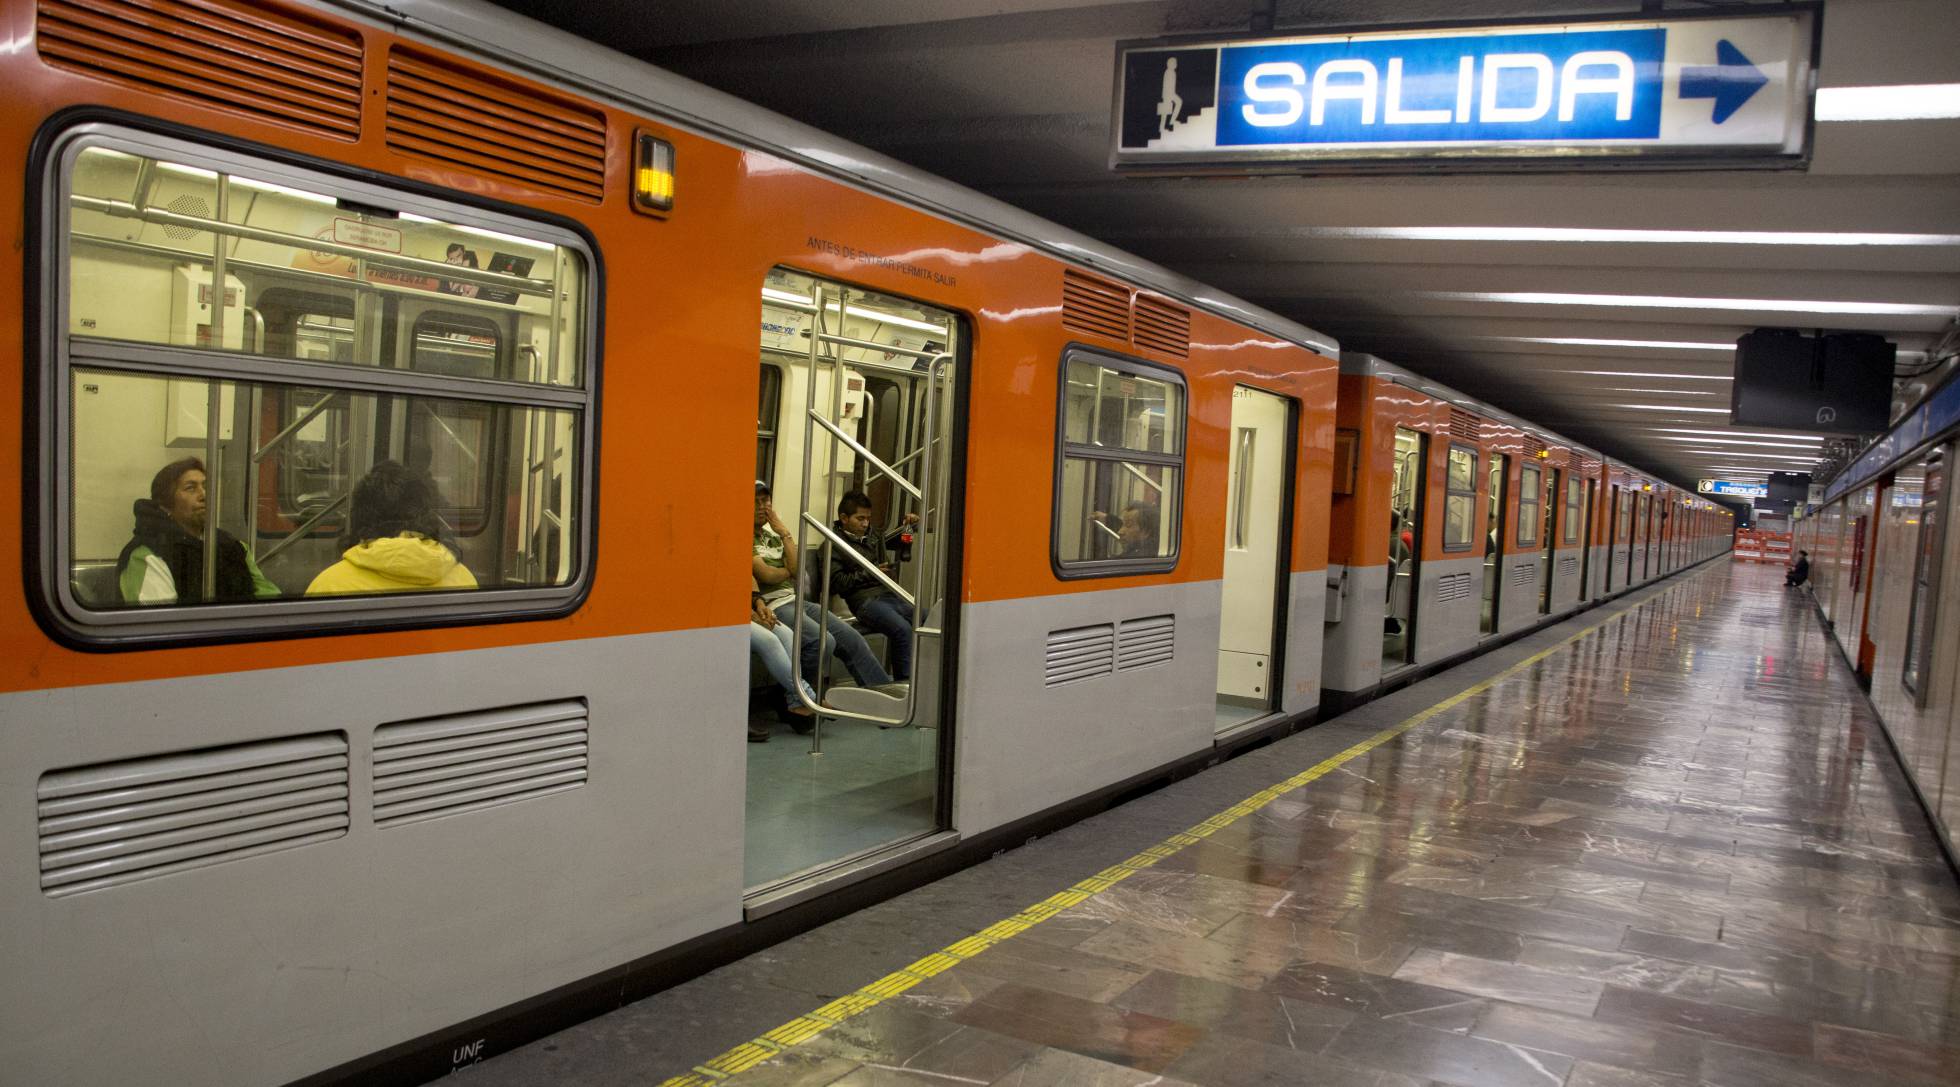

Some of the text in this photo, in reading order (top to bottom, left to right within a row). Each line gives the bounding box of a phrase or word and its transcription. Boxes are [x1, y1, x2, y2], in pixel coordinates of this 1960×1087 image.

[1241, 50, 1635, 127] SALIDA
[806, 237, 957, 288] ANTES DE ENTRAR PERMITA SALIR
[453, 1039, 485, 1064] UNF
